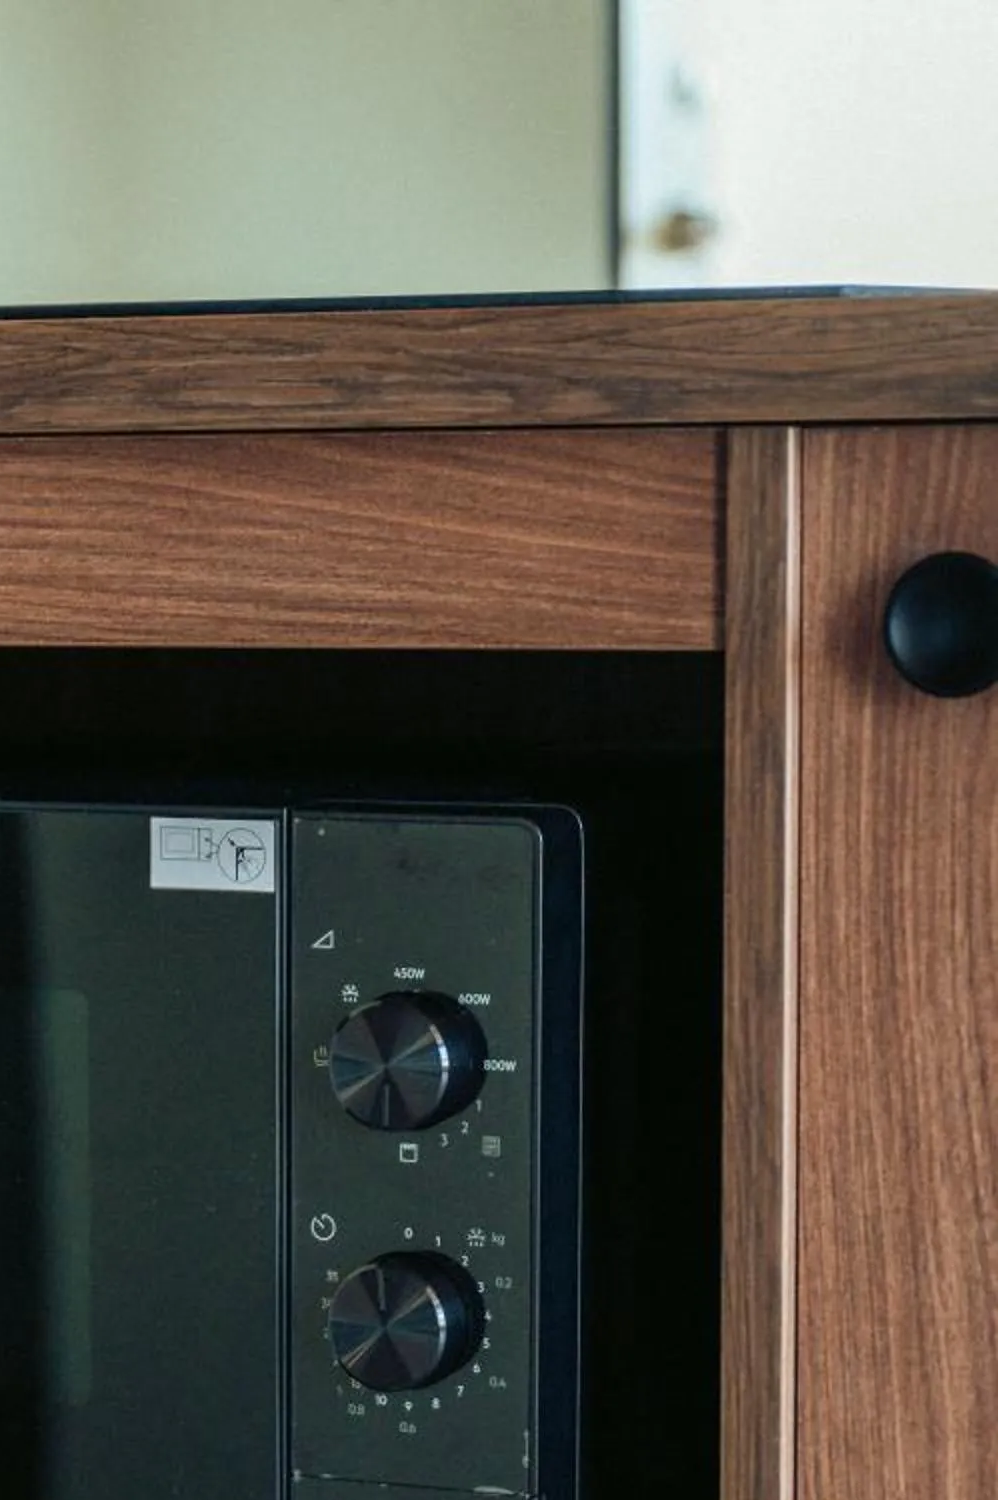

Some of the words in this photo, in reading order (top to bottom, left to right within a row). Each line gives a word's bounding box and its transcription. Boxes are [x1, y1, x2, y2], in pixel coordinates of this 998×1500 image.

[393, 966, 426, 980] 450W
[457, 993, 492, 1006] 600W
[483, 1059, 518, 1072] 800W
[460, 1121, 470, 1135] 2
[440, 1133, 450, 1148] 3
[403, 1227, 414, 1241] 0
[490, 1231, 506, 1247] kg
[460, 1255, 470, 1267] 2
[476, 1281, 485, 1293] 3
[482, 1337, 491, 1350] 5
[374, 1393, 388, 1407] 10
